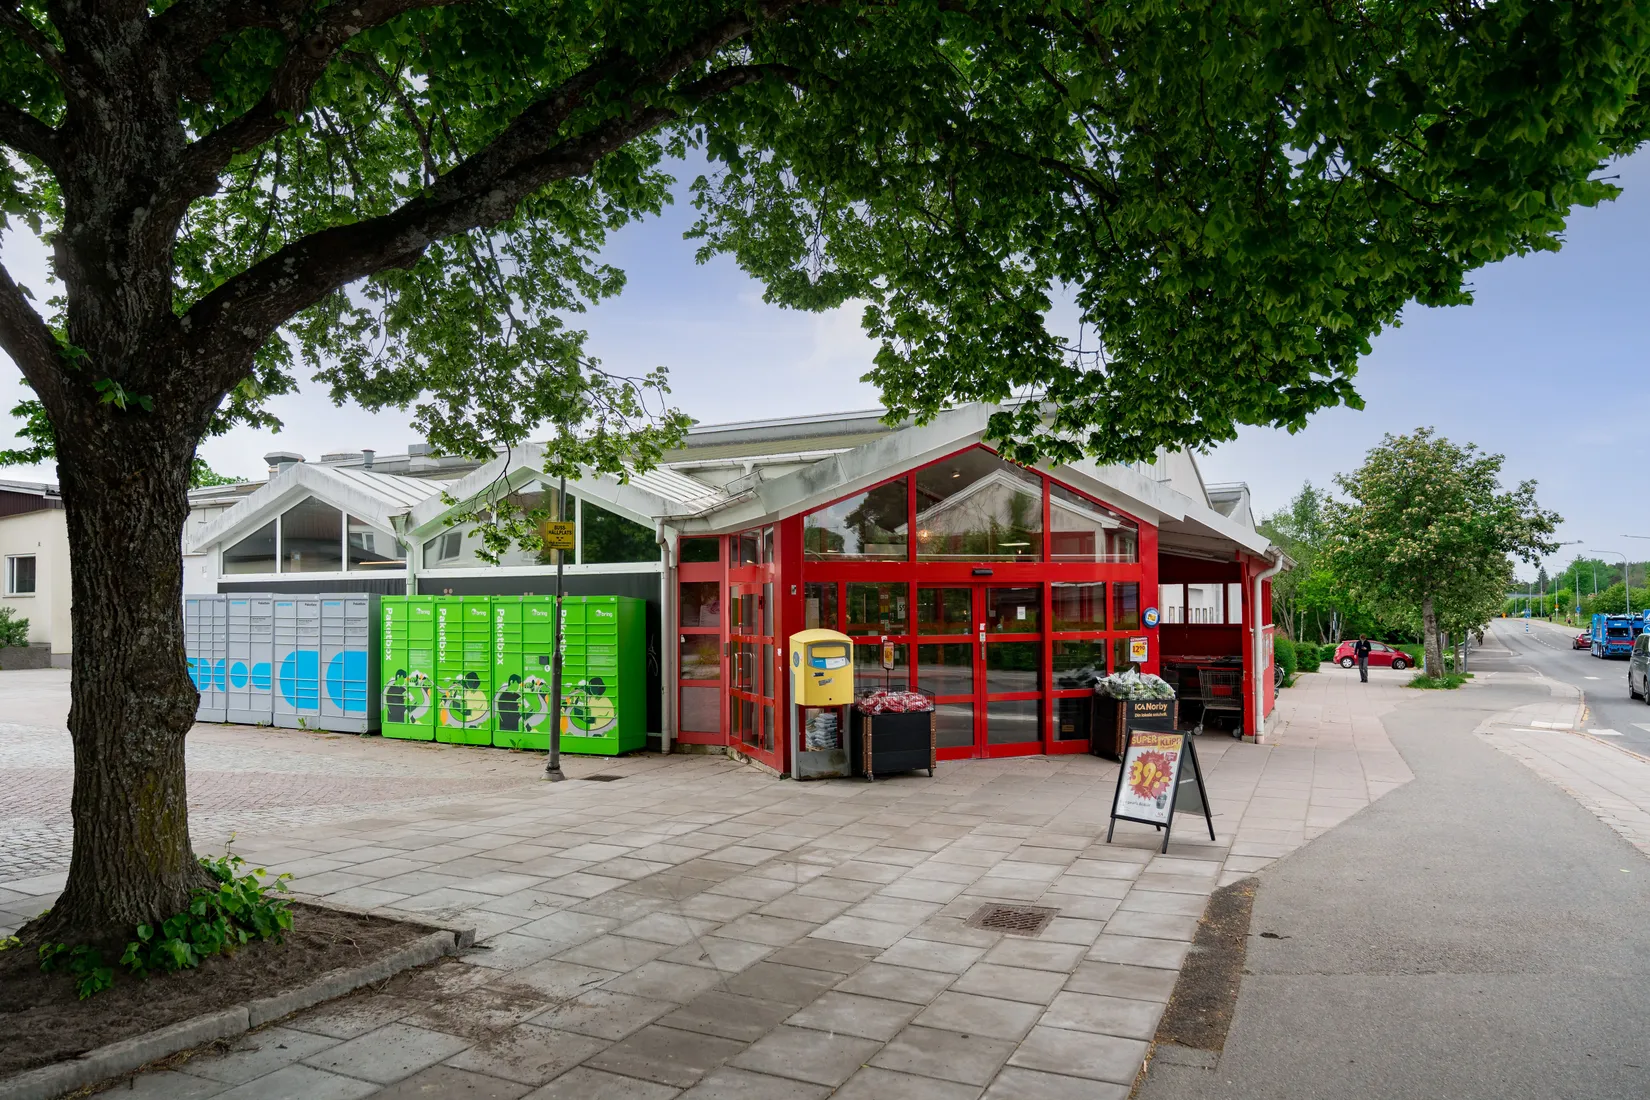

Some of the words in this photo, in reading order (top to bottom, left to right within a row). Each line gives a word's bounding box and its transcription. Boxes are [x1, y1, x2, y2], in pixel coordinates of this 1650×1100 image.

[385, 607, 393, 661] Paketbox
[439, 608, 447, 663] Paketbox
[496, 608, 505, 666] Paketbox
[1134, 703, 1146, 711] ICA
[1146, 702, 1168, 711] Norby
[1131, 735, 1157, 745] SUPER
[1129, 761, 1170, 789] 39:-
